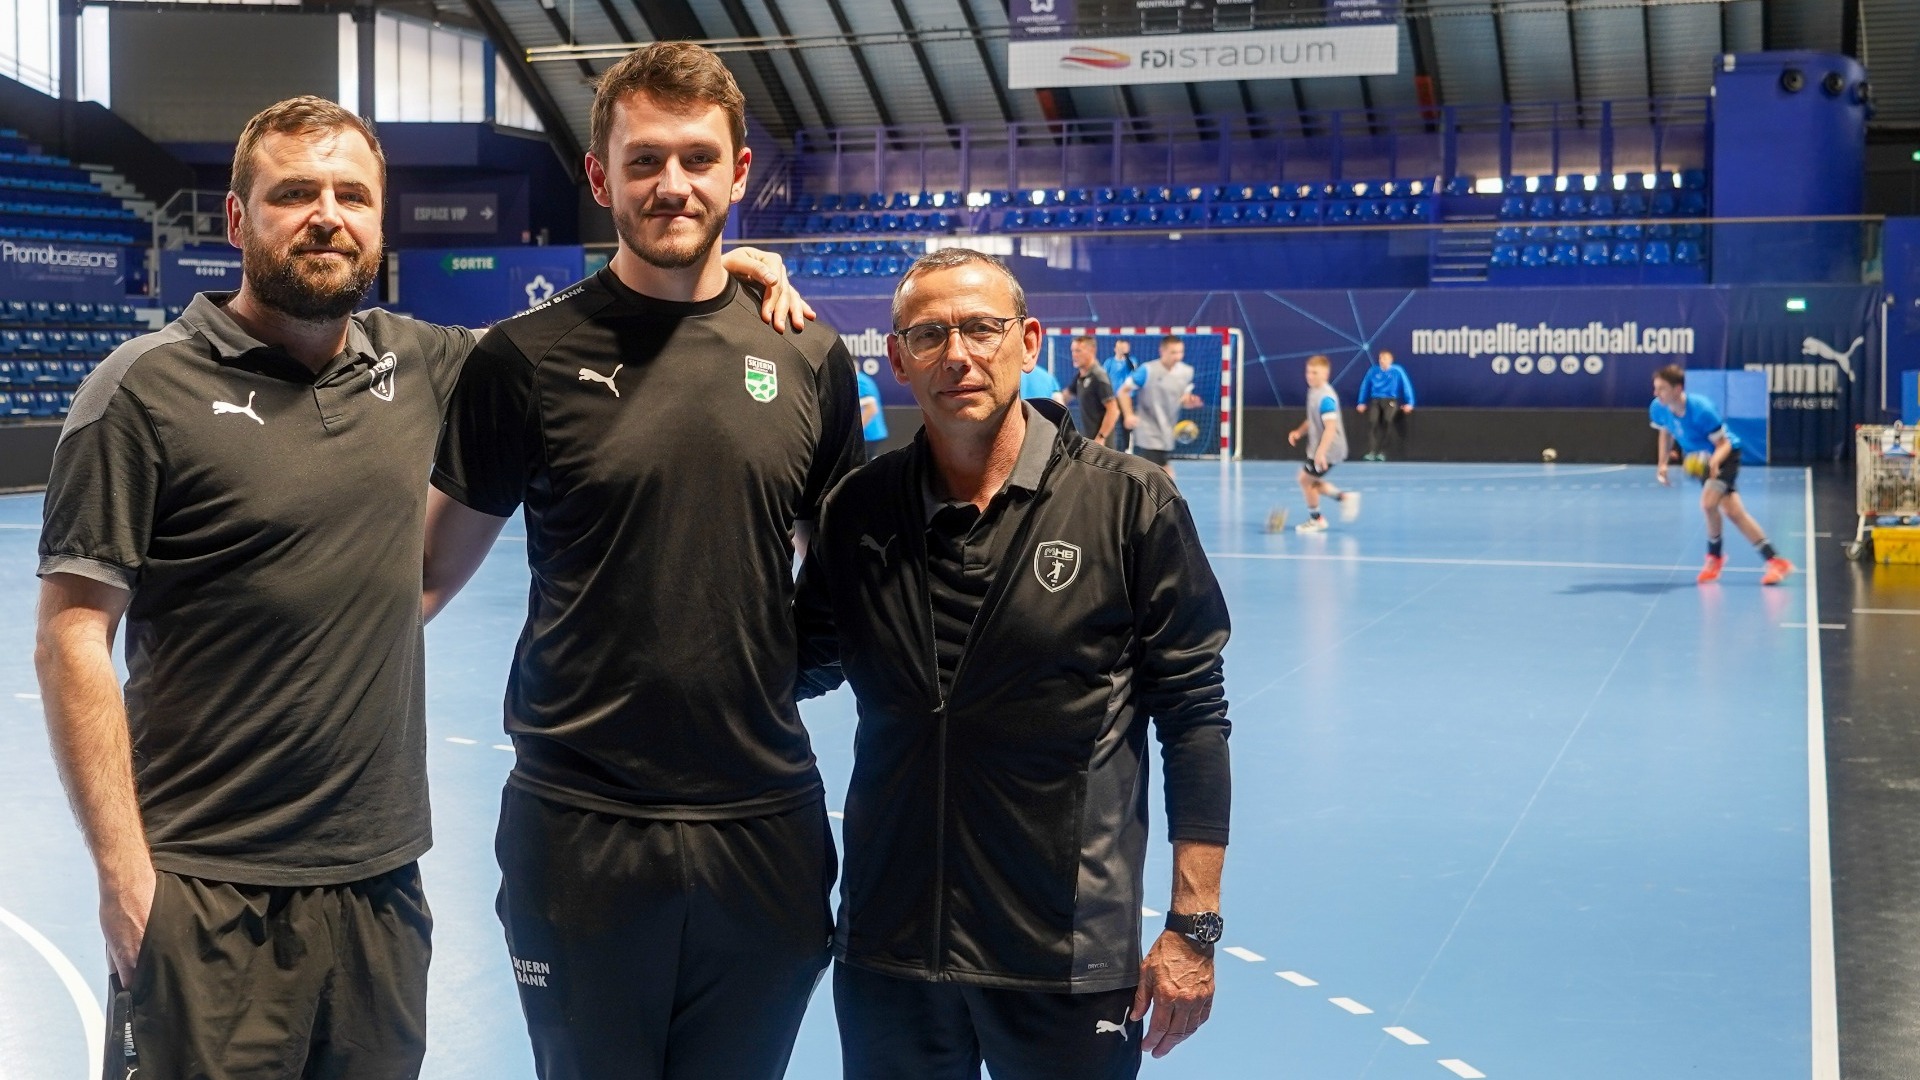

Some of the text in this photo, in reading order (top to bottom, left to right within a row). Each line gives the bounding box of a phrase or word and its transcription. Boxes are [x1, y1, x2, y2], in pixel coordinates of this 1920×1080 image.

[451, 256, 494, 270] SORTIE
[552, 285, 586, 304] BANK
[1411, 321, 1695, 359] montpellierhandball.com
[1044, 547, 1074, 559] MHB
[512, 955, 550, 975] SKJERN
[516, 970, 548, 988] BANK
